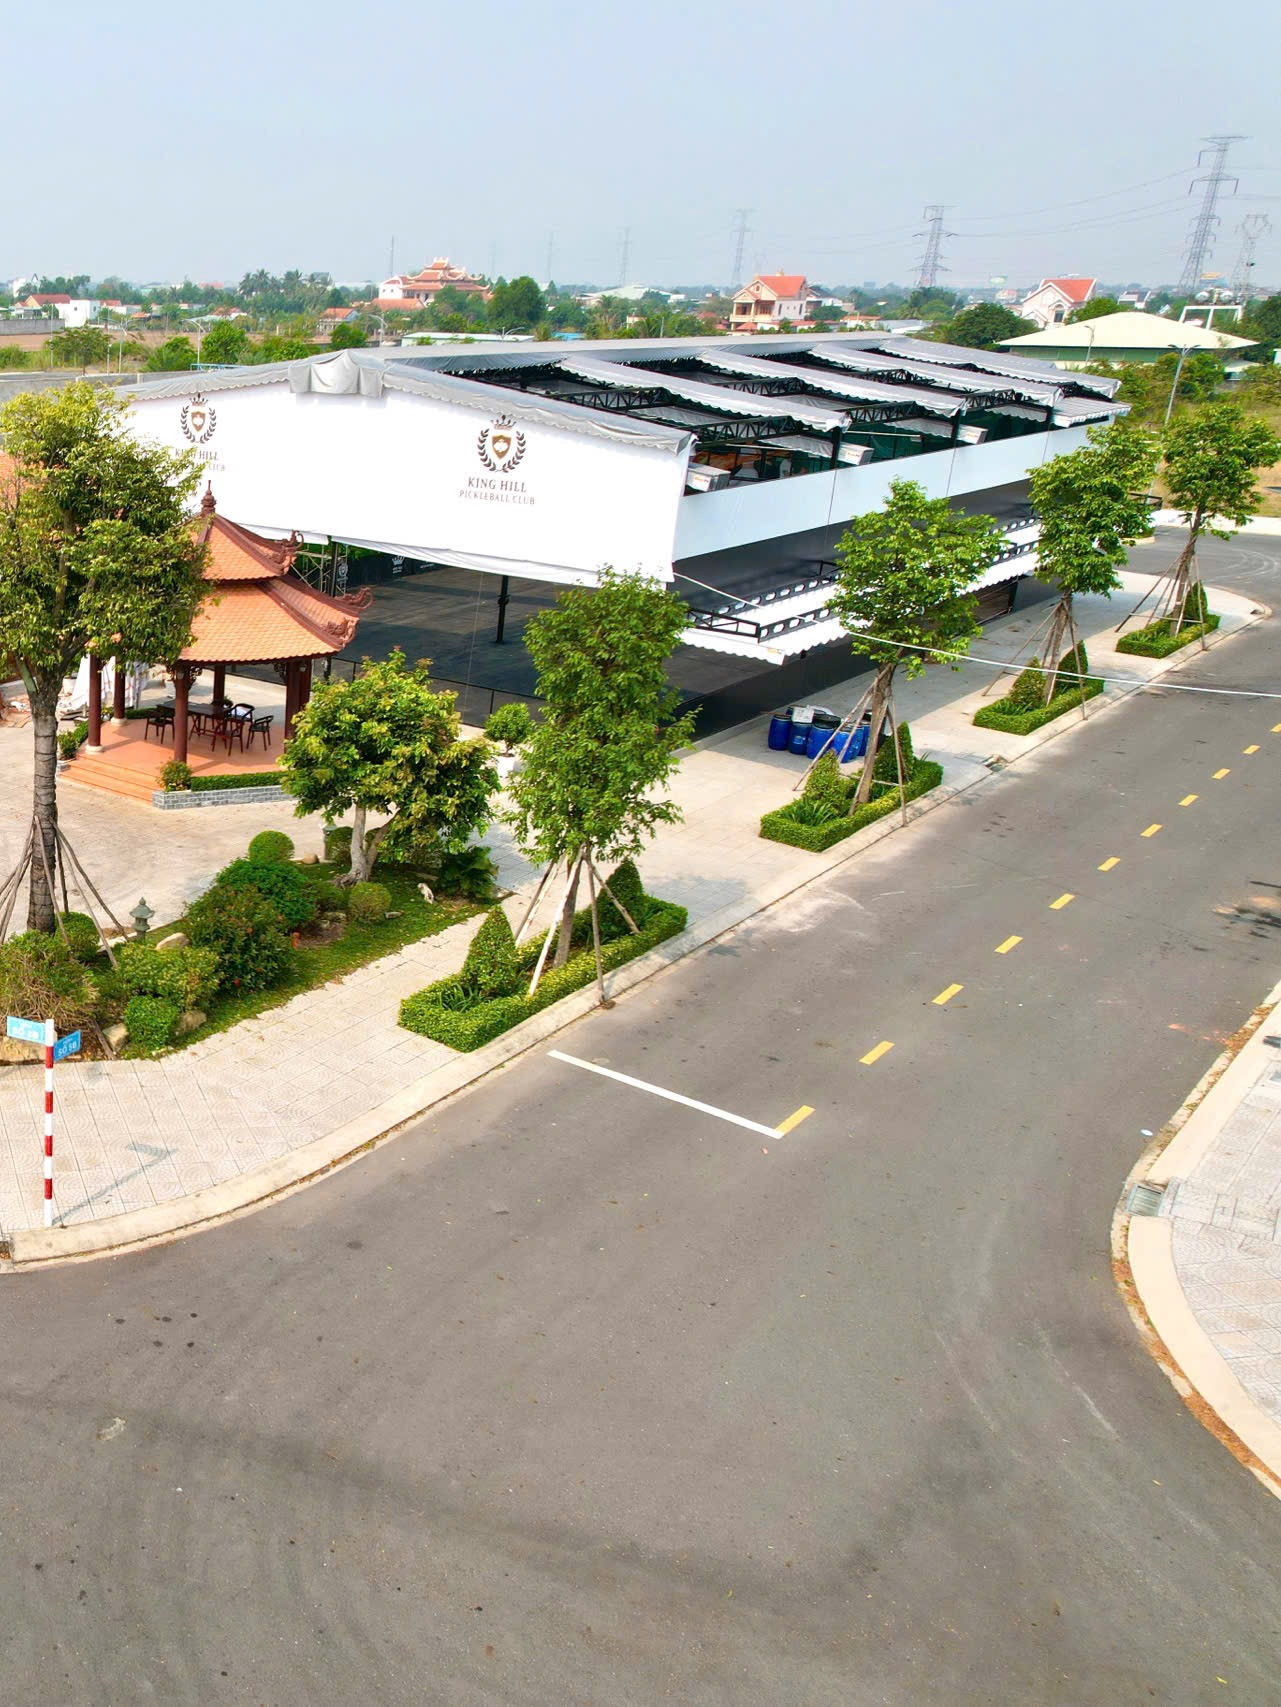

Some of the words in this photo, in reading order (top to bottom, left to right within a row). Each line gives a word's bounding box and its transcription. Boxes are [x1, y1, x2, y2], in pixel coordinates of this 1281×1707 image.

[199, 450, 220, 461] HILL
[467, 476, 496, 490] KING
[500, 480, 527, 493] HILL
[459, 489, 510, 504] PICKLEBALL
[512, 495, 535, 505] CLUB
